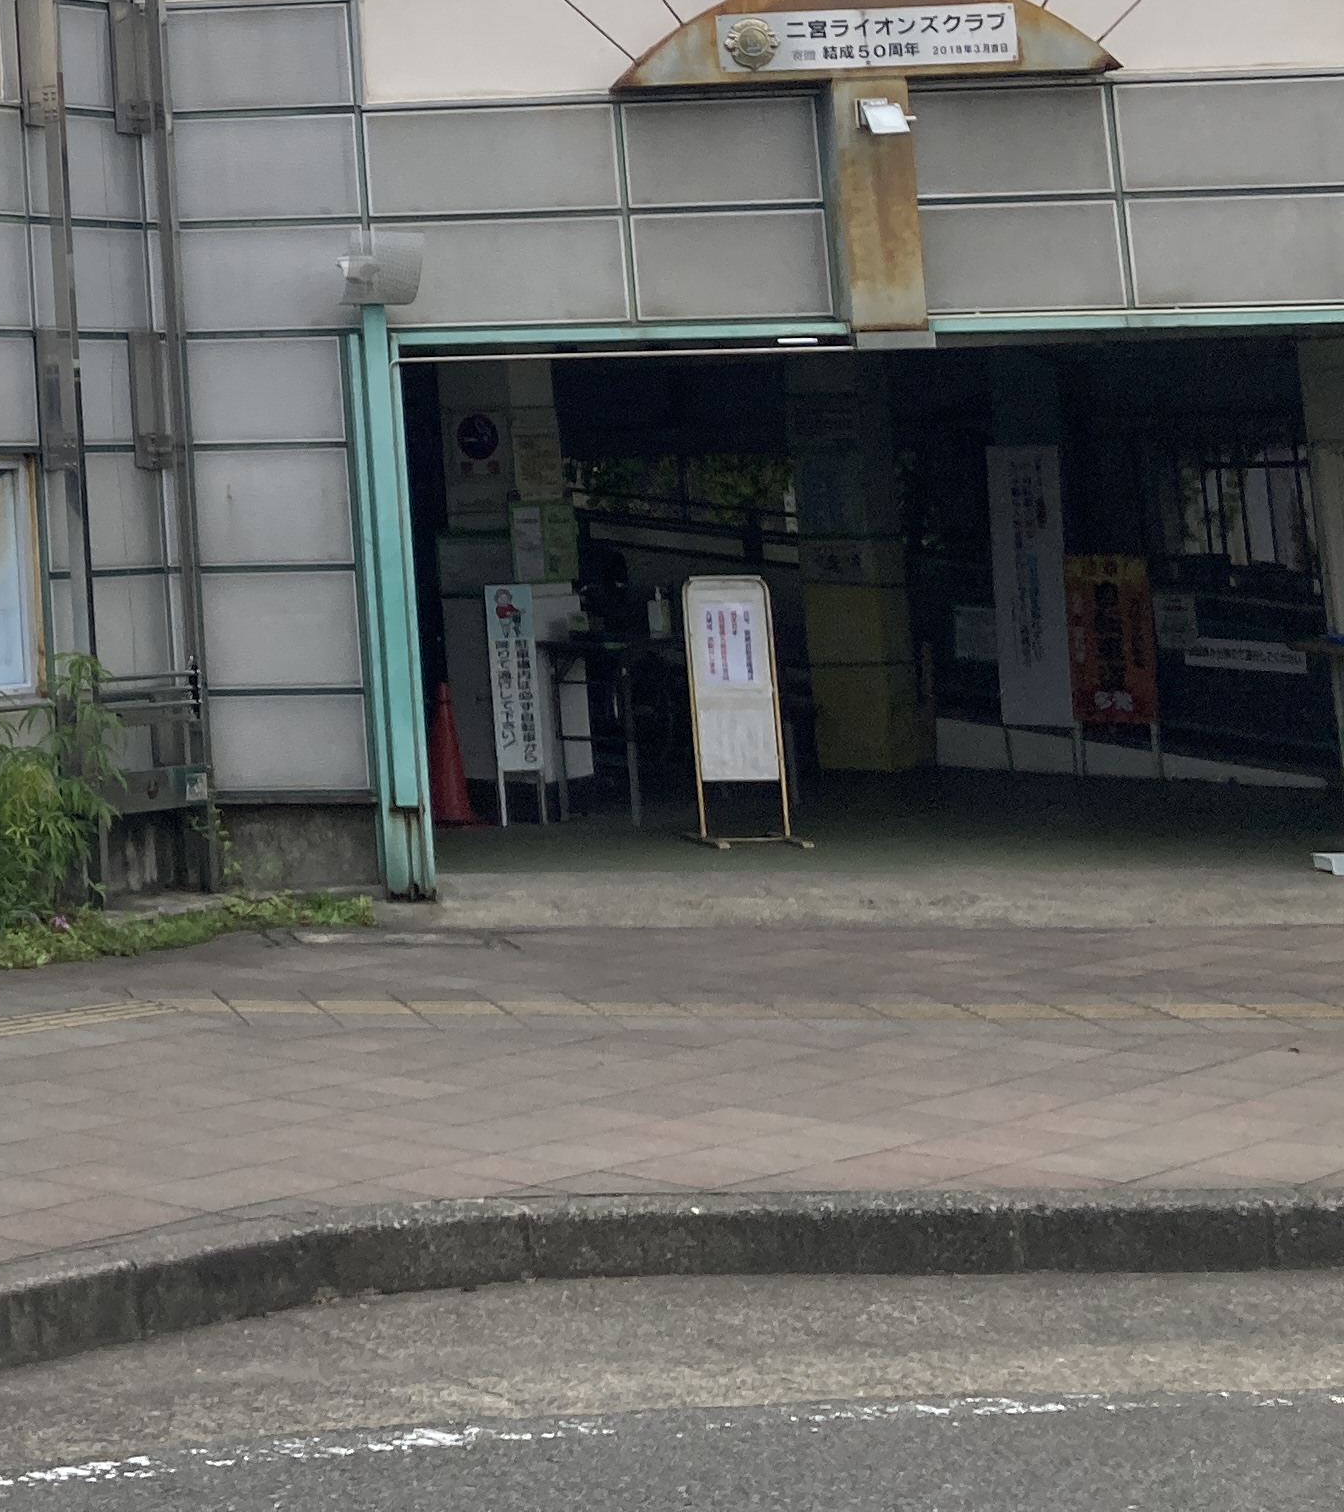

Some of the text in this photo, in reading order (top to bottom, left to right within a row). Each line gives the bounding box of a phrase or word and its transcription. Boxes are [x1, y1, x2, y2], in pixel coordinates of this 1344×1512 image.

[786, 12, 1006, 39] 二宮ライオンズクラブ
[822, 42, 921, 60] 結成50周年
